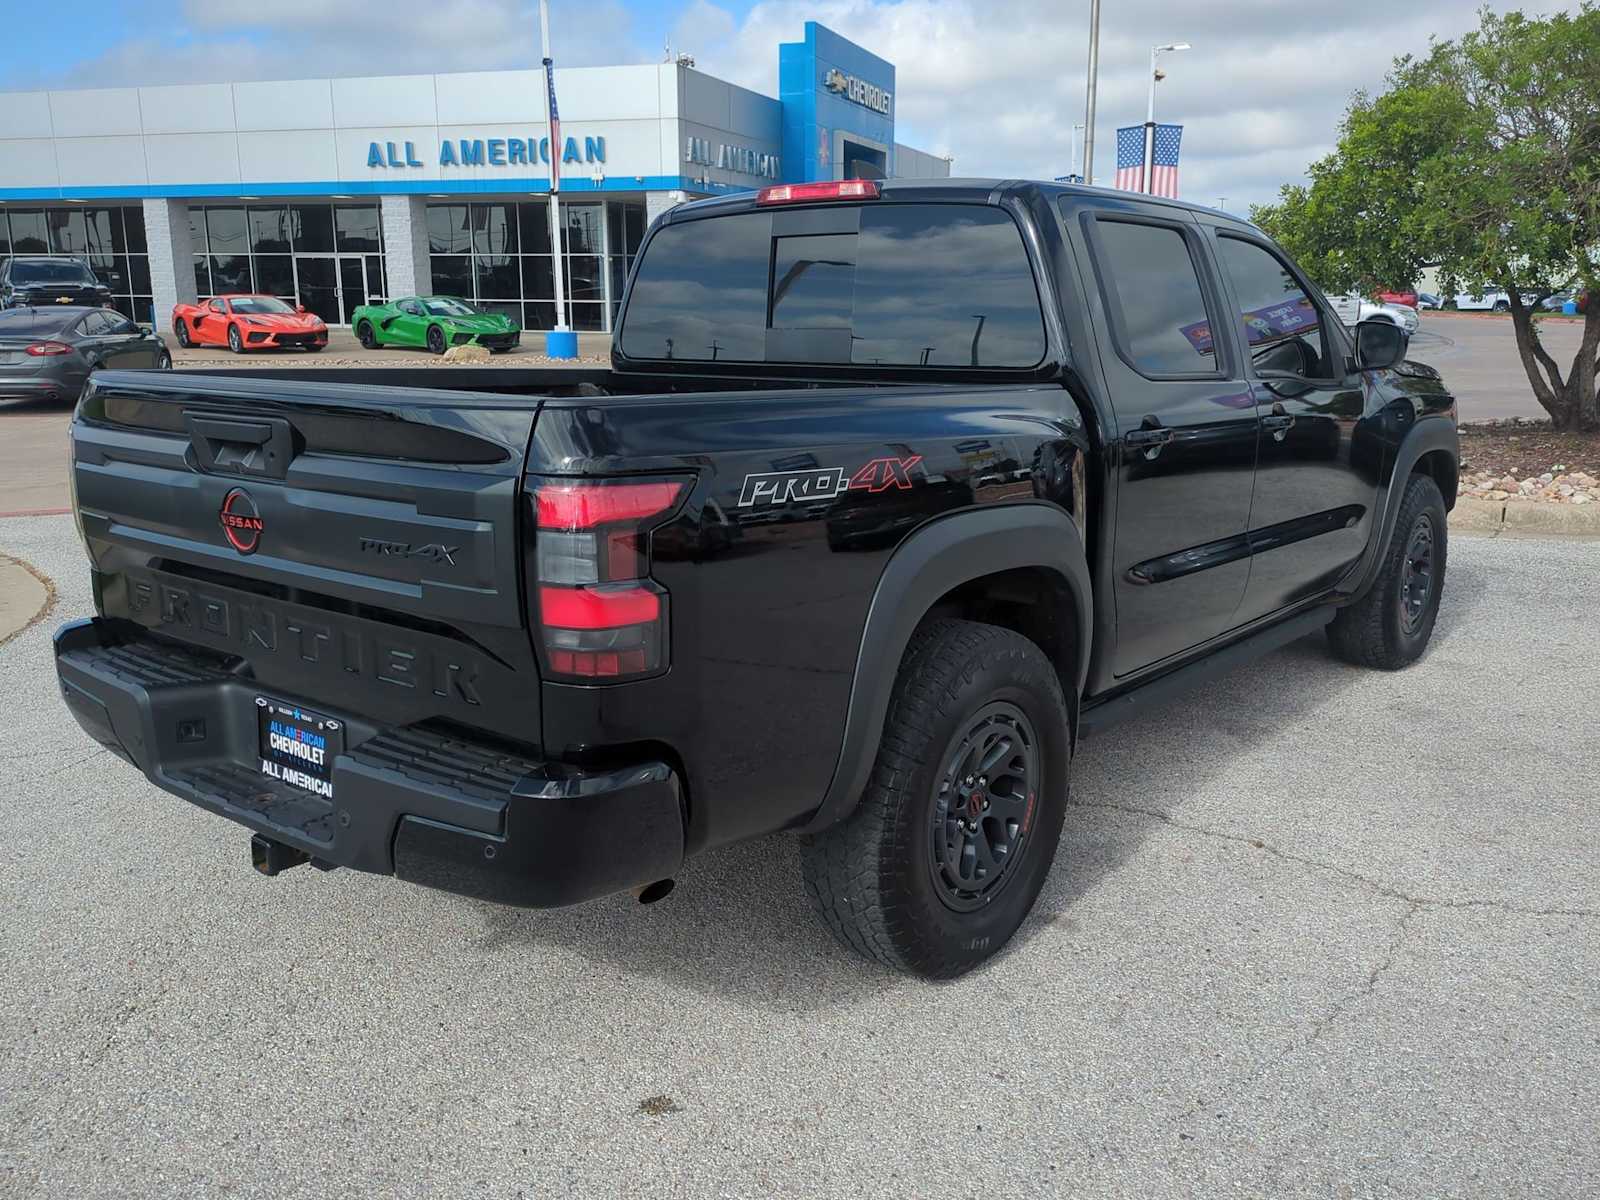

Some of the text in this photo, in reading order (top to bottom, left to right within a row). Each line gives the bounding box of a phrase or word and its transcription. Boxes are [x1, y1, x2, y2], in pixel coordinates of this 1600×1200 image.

[848, 76, 892, 114] CHEVROLET
[367, 140, 423, 168] ALL
[685, 136, 781, 179] ALL AMERICAN
[128, 582, 482, 706] FRONTIER
[270, 721, 325, 748] ALL AMERICAN
[270, 732, 325, 766] CHEVROLET
[262, 760, 281, 779] ALL
